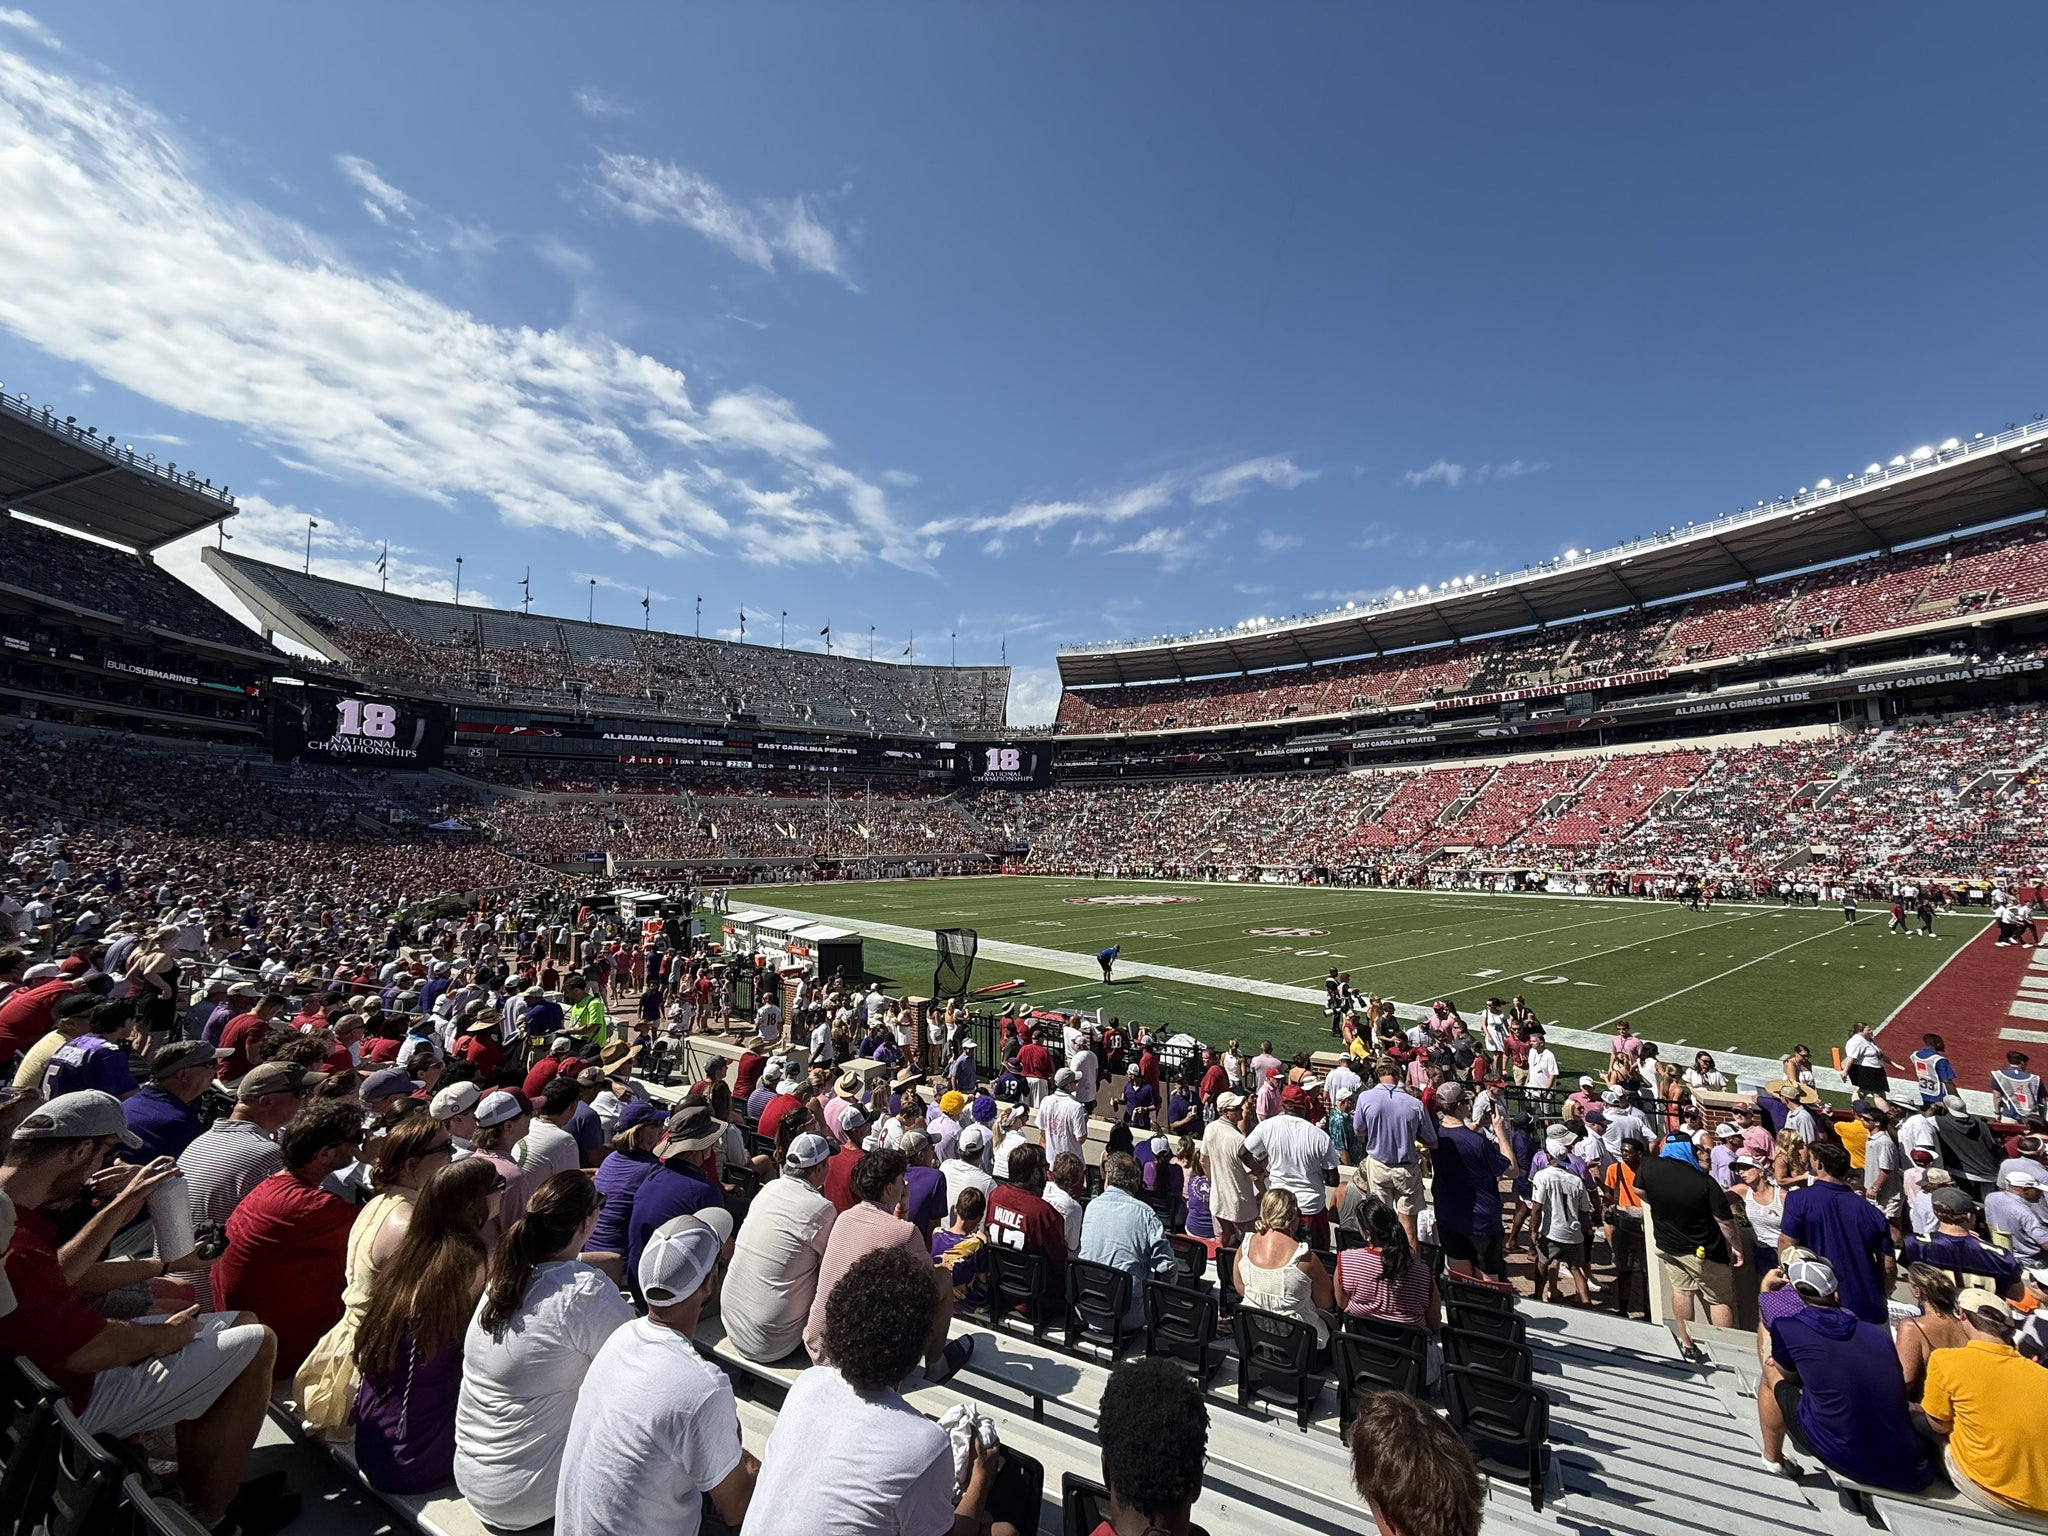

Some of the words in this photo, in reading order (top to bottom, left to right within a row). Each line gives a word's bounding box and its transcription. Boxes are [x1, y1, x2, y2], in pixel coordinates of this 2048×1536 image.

[107, 660, 199, 685] BUILDSUBMARINES
[1858, 680, 1894, 693] EAST
[1896, 670, 1972, 688] CAROLINA
[1973, 659, 2045, 678] PIRATES
[1436, 697, 1471, 709] SABAN
[1472, 694, 1503, 705] FIELD
[1517, 679, 1608, 700] BRYANT-DENNY
[1608, 669, 1669, 687] STADIUM
[1675, 702, 1728, 716] ALABAMA
[1729, 696, 1781, 709] CRIMSON
[1782, 691, 1811, 702] TIDE
[336, 699, 397, 739] 18
[331, 735, 398, 750] NATIONAL
[602, 732, 655, 742] ALABAMA
[656, 736, 701, 745] CRIMSON
[1352, 741, 1371, 749] EAST
[1371, 738, 1405, 748] CAROLINA
[1405, 735, 1437, 744] PIRATES
[308, 740, 417, 758] CHAMPIONSHIPS
[470, 749, 481, 757] 25
[782, 744, 823, 753] CAROLINA
[824, 747, 858, 755] PIRATES
[1255, 748, 1285, 757] ALABAMA
[1286, 746, 1314, 755] CRIMSON
[657, 757, 664, 765] 0
[985, 748, 1020, 771] 18
[573, 854, 584, 862] 25
[767, 1013, 777, 1026] 18
[1110, 1034, 1123, 1049] 18
[1919, 1077, 1935, 1091] 33
[994, 1205, 1024, 1229] WADDLE
